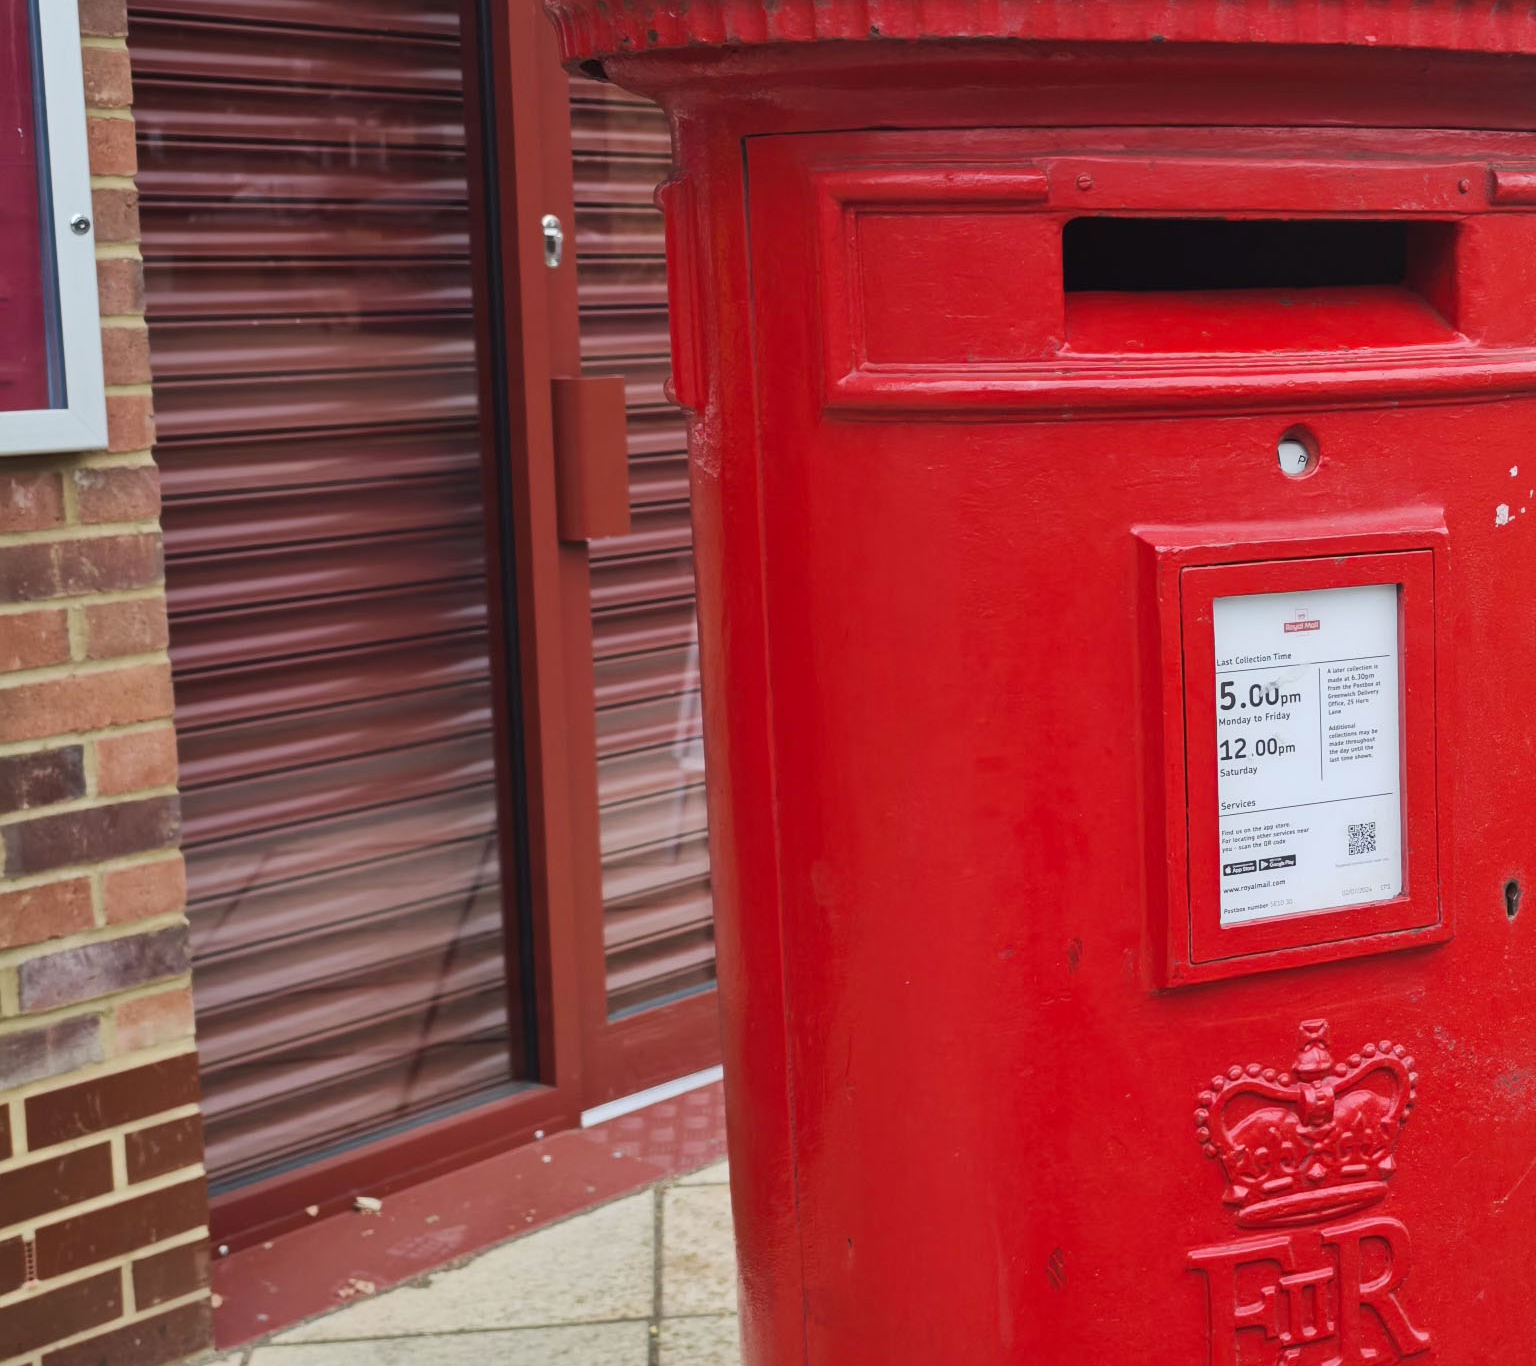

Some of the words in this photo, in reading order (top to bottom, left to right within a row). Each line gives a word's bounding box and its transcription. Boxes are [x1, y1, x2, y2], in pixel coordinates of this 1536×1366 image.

[1235, 655, 1271, 664] Collection
[1273, 652, 1291, 660] Time
[1351, 673, 1375, 681] 6.30pm
[1328, 691, 1356, 699] Greenwich
[1219, 717, 1251, 726] Monday
[1265, 711, 1290, 721] Friday
[1329, 723, 1356, 731] Additional
[1329, 731, 1357, 739] collections
[1220, 766, 1257, 777] Saturday
[1221, 799, 1256, 810] Services
[1233, 835, 1255, 843] locating
[1224, 879, 1285, 894] www.royalmail.com
[1247, 903, 1268, 911] number
